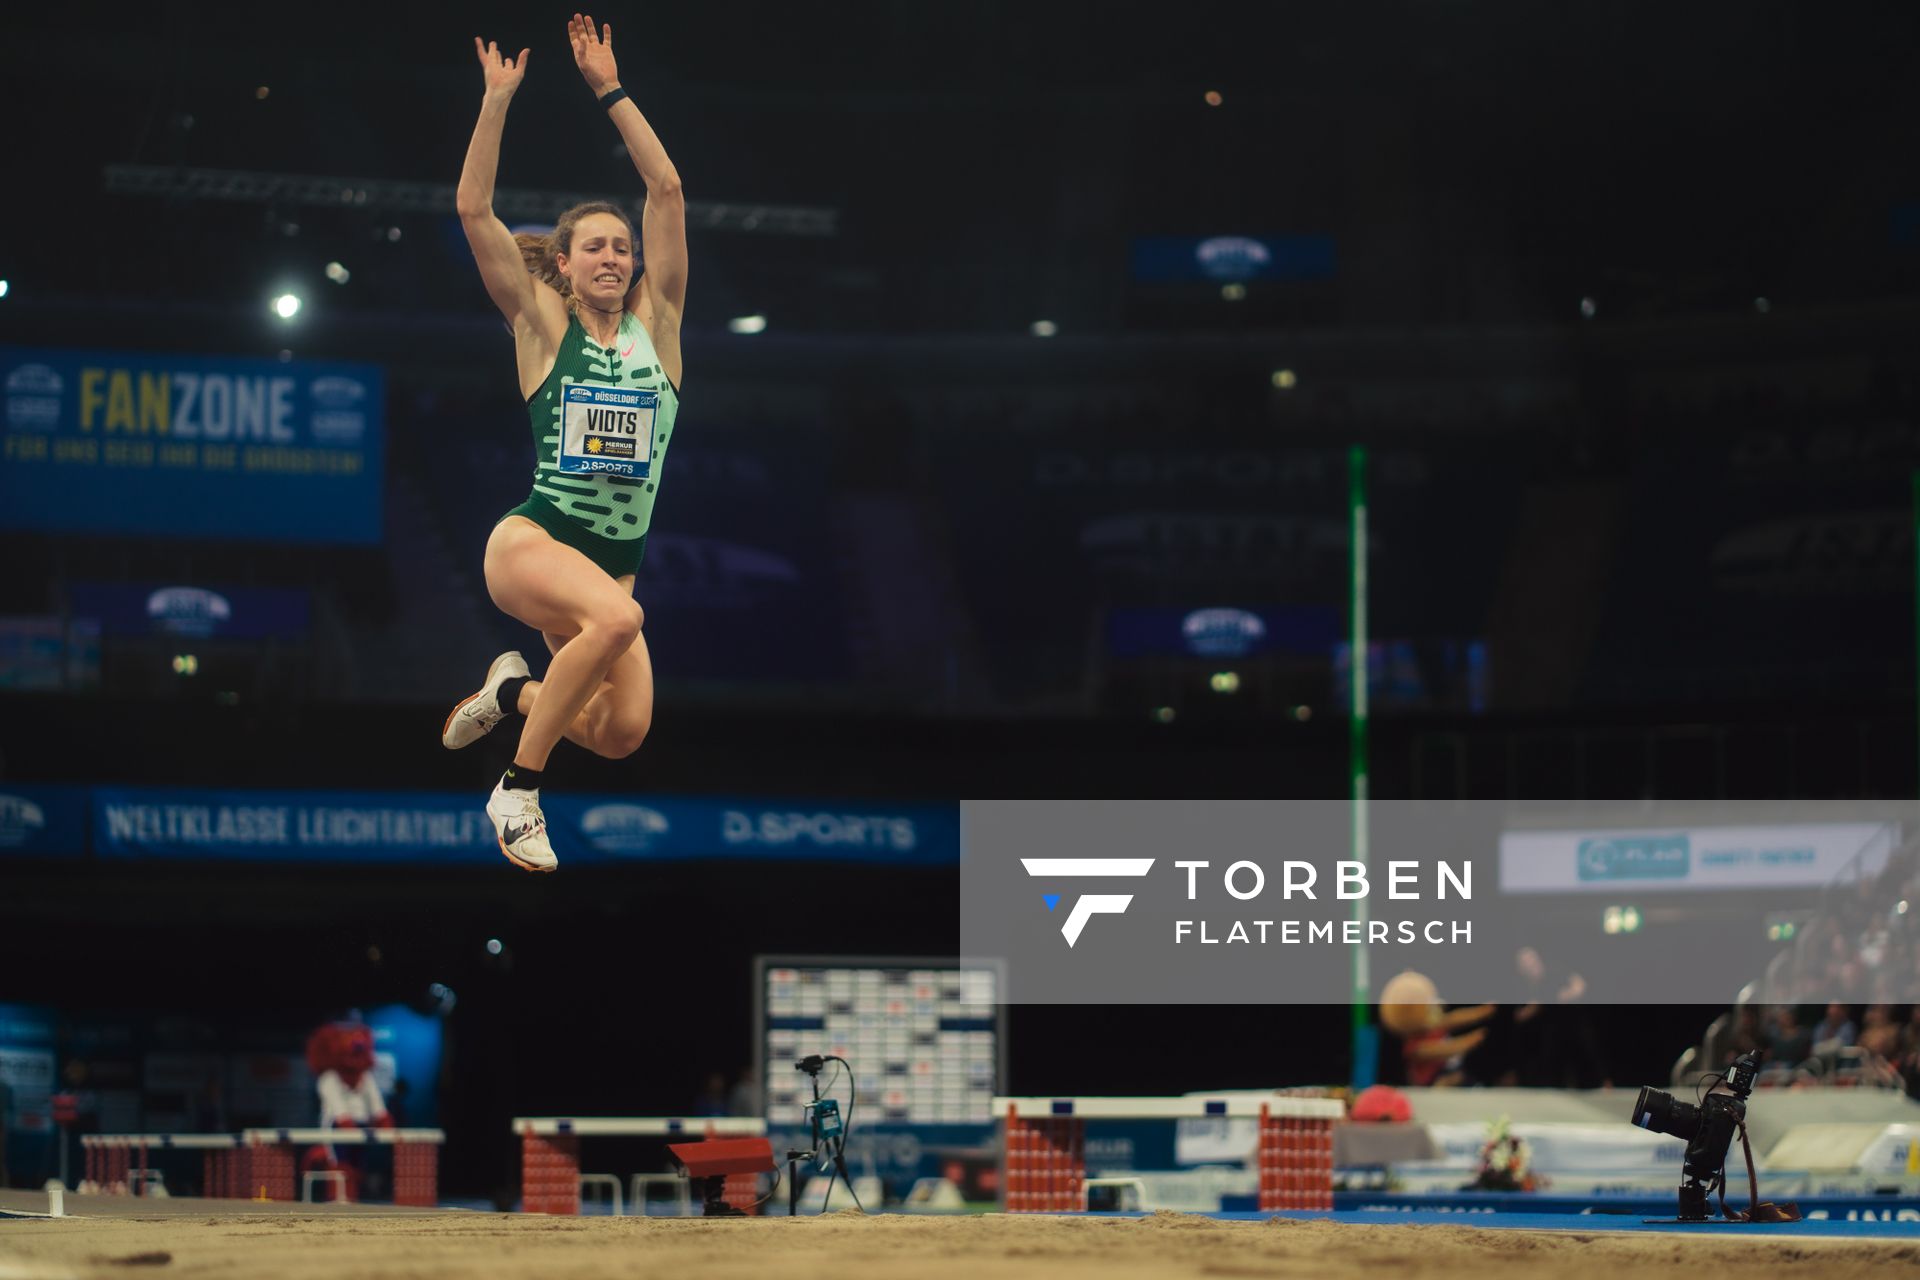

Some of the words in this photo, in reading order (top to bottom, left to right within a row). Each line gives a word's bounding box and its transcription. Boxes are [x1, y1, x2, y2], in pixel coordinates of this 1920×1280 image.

[77, 366, 298, 445] FANZONE
[594, 391, 640, 405] DÜSSELDORF
[587, 408, 638, 435] VIDTS
[605, 441, 633, 449] MERKUR
[581, 460, 634, 474] D.SPORTS
[105, 802, 291, 844] WELTKLASSE
[722, 810, 917, 851] D.SPORTS
